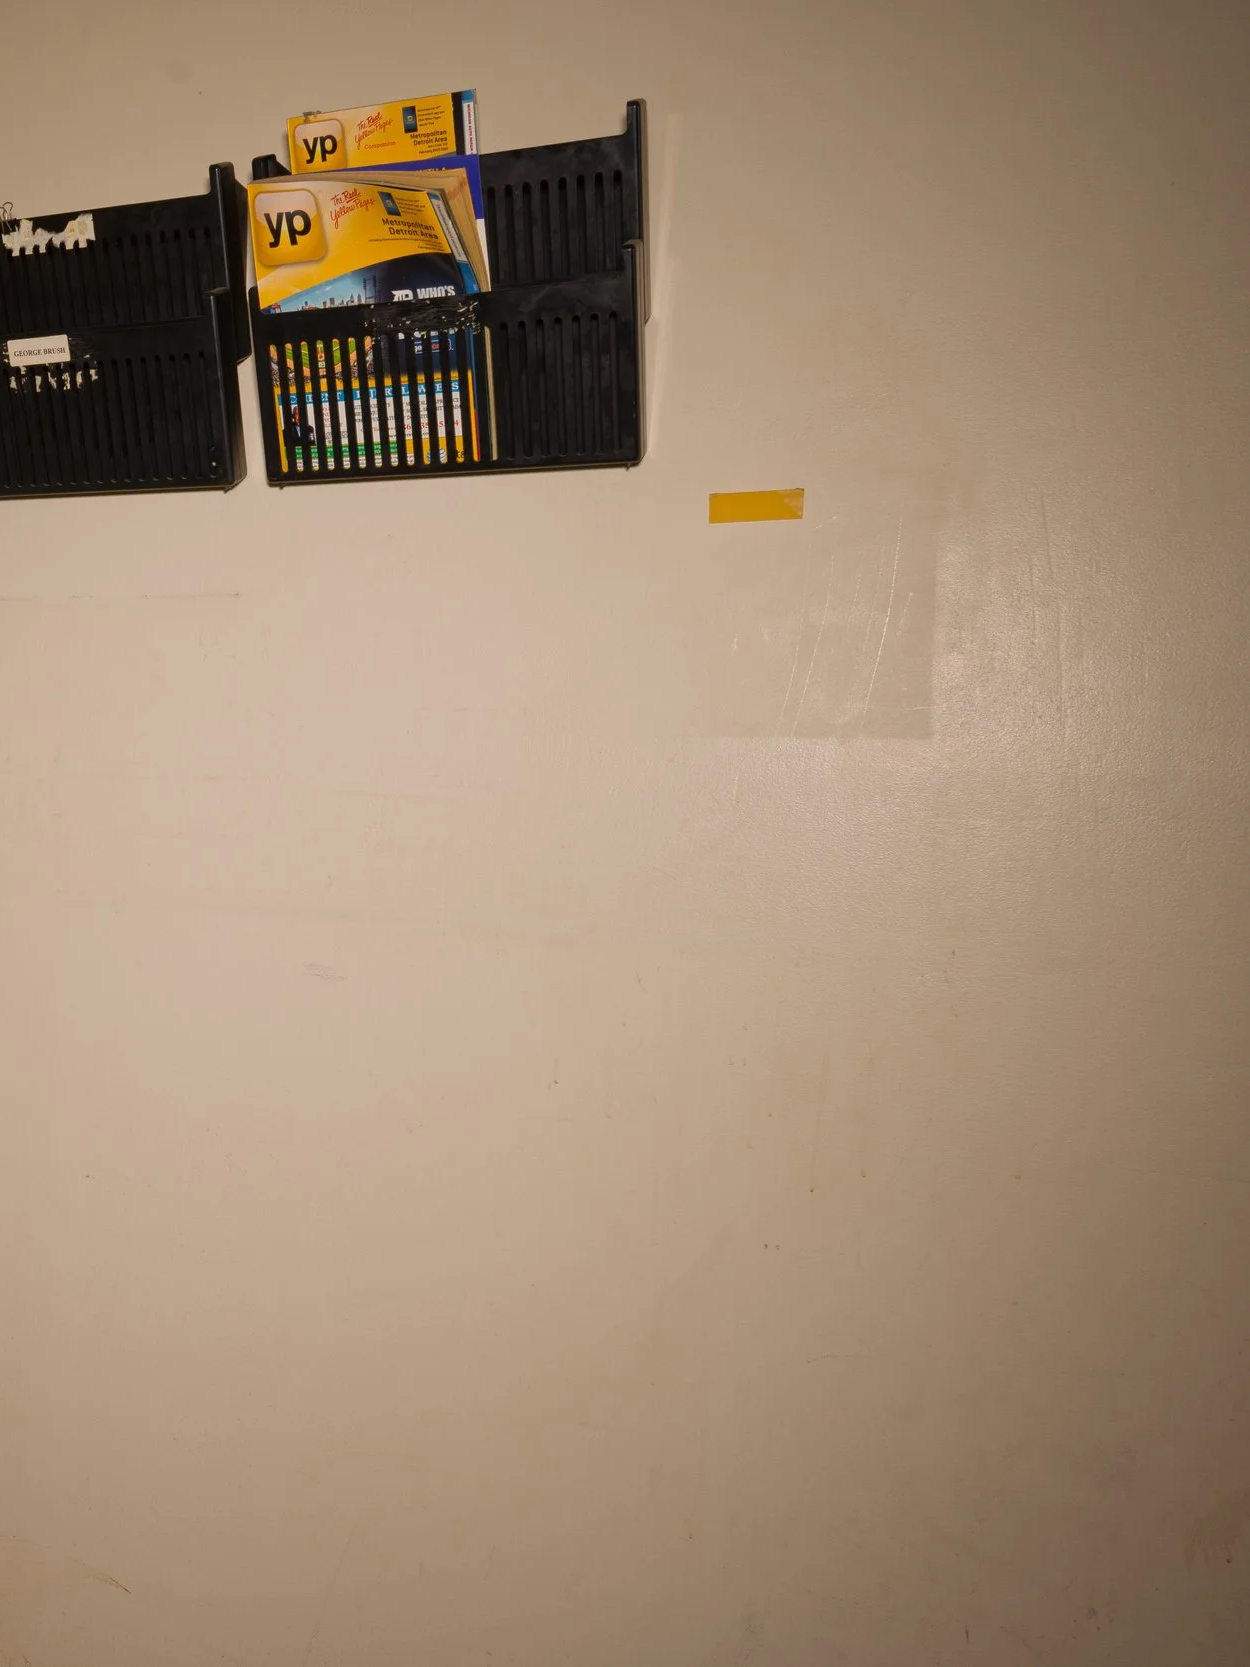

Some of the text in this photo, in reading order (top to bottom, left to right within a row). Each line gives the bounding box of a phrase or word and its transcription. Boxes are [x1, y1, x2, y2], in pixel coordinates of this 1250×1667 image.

[410, 130, 447, 139] Metropolitan
[302, 134, 338, 164] yp
[413, 138, 434, 146] Detroit
[264, 208, 312, 248] yp
[381, 217, 436, 232] Metropolitan
[388, 227, 439, 240] Detroit Area
[416, 285, 456, 300] WHO'S
[14, 347, 66, 357] GEORGE BRUSH
